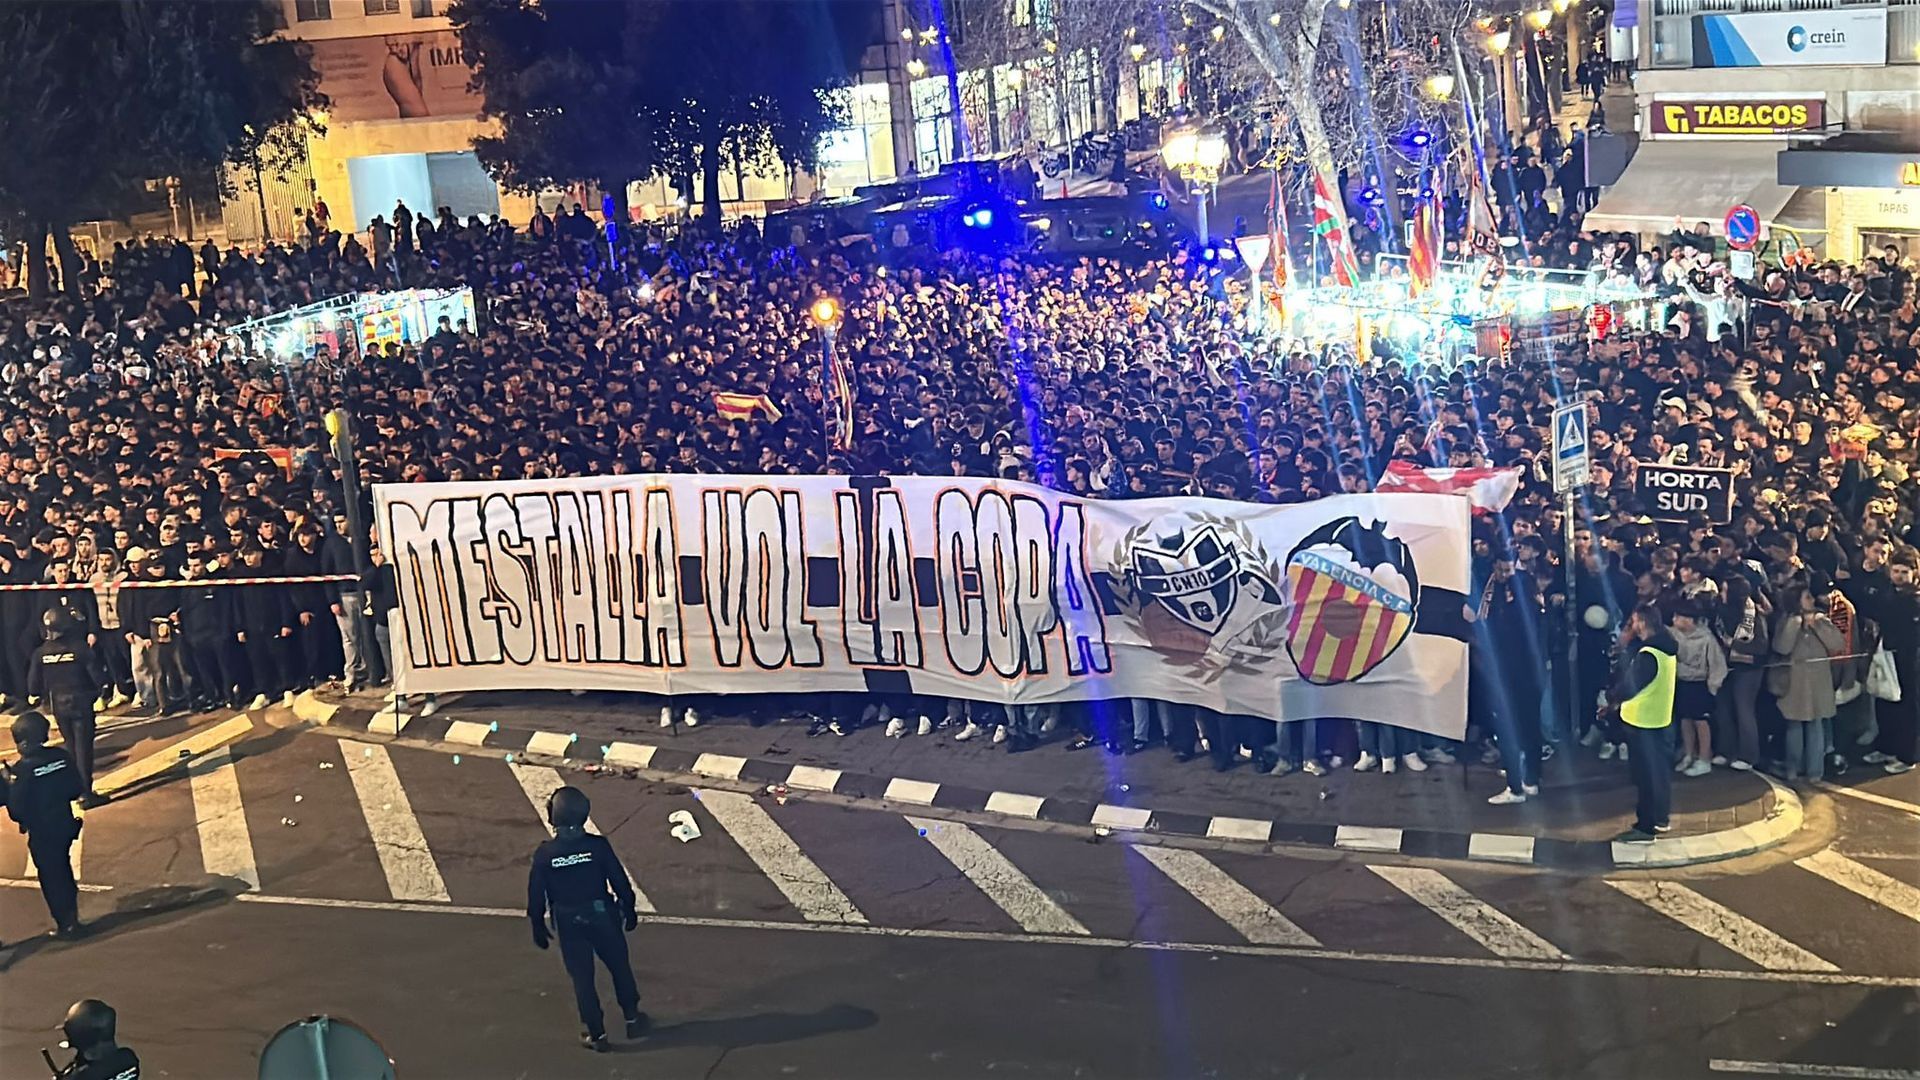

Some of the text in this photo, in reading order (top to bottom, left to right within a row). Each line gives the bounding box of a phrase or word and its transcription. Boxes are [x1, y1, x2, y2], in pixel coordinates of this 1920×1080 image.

[1810, 29, 1845, 44] crein
[1694, 105, 1807, 125] TABACOS
[1903, 162, 1920, 185] A
[1878, 203, 1909, 214] TAPAS
[1645, 471, 1722, 490] HORTA
[1657, 492, 1708, 511] SUD
[389, 486, 1112, 679] MESTALLA VOL LA COPA
[1171, 573, 1209, 593] CN10
[1301, 553, 1378, 597] VALENCIA
